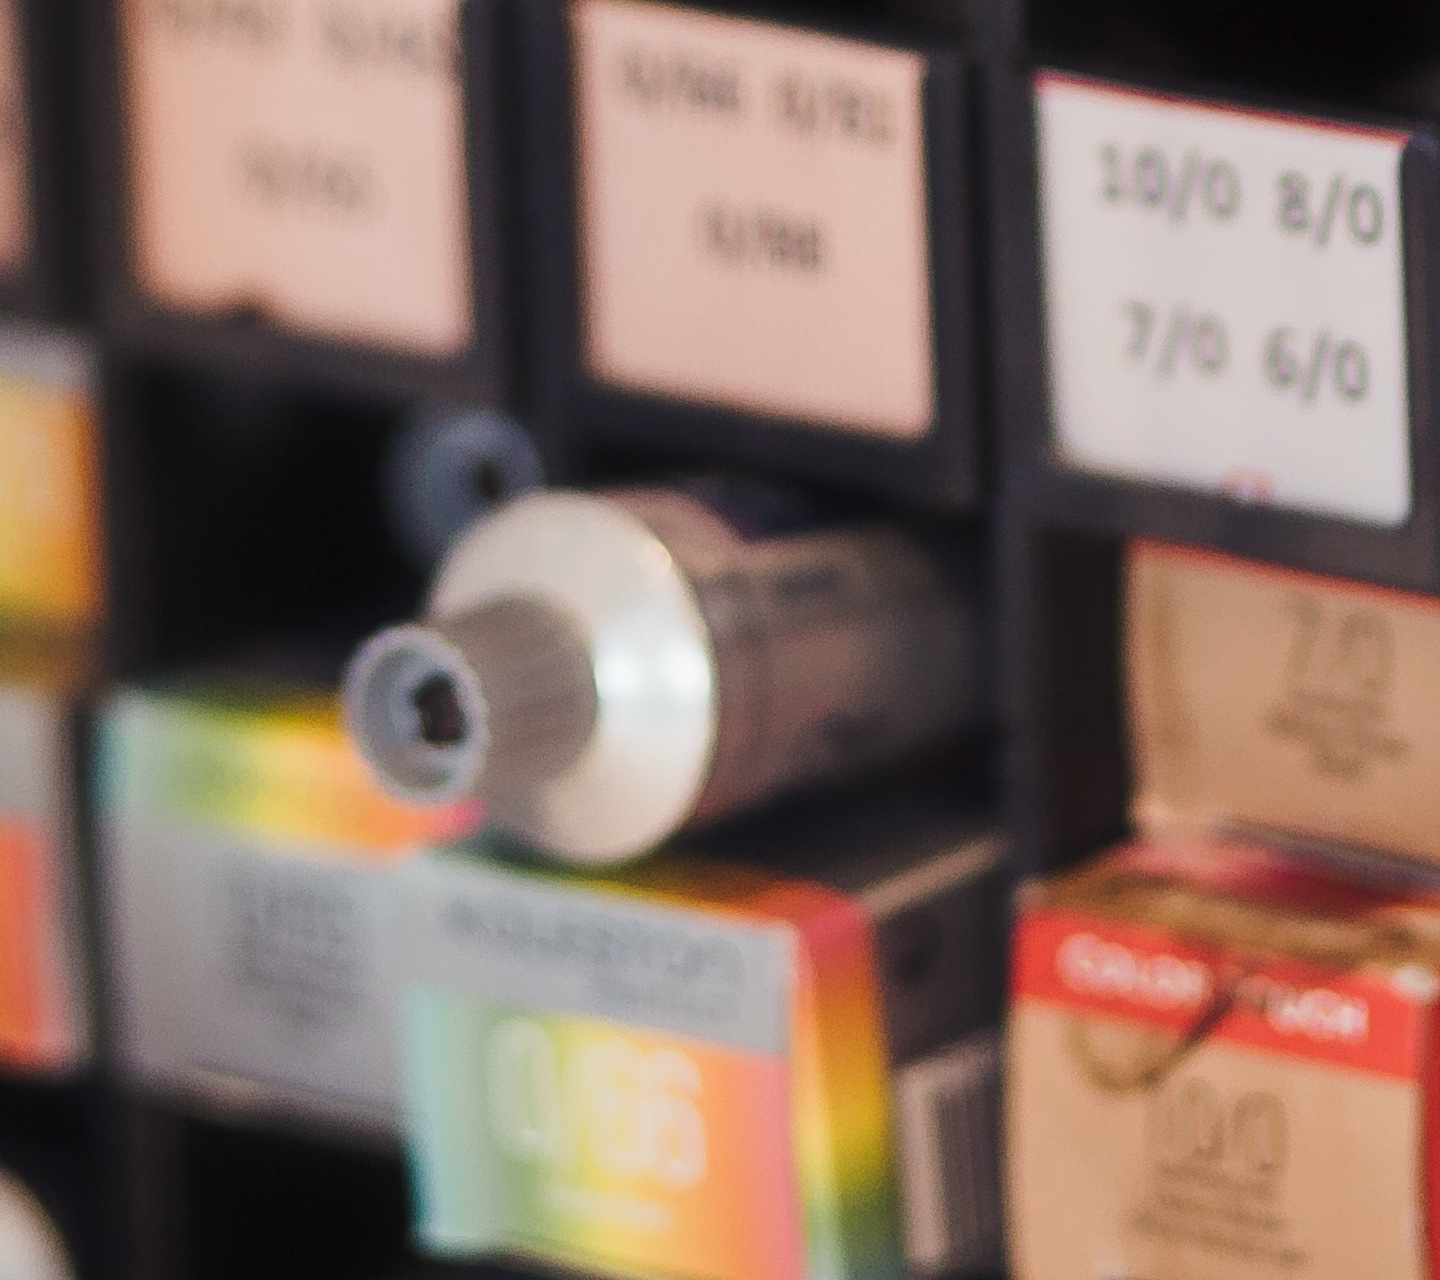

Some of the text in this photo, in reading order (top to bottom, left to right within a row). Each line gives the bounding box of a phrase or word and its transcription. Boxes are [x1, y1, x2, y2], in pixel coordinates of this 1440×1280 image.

[1100, 140, 1385, 252] 10/0 8/0
[1122, 298, 1372, 408] 7/0 6/0
